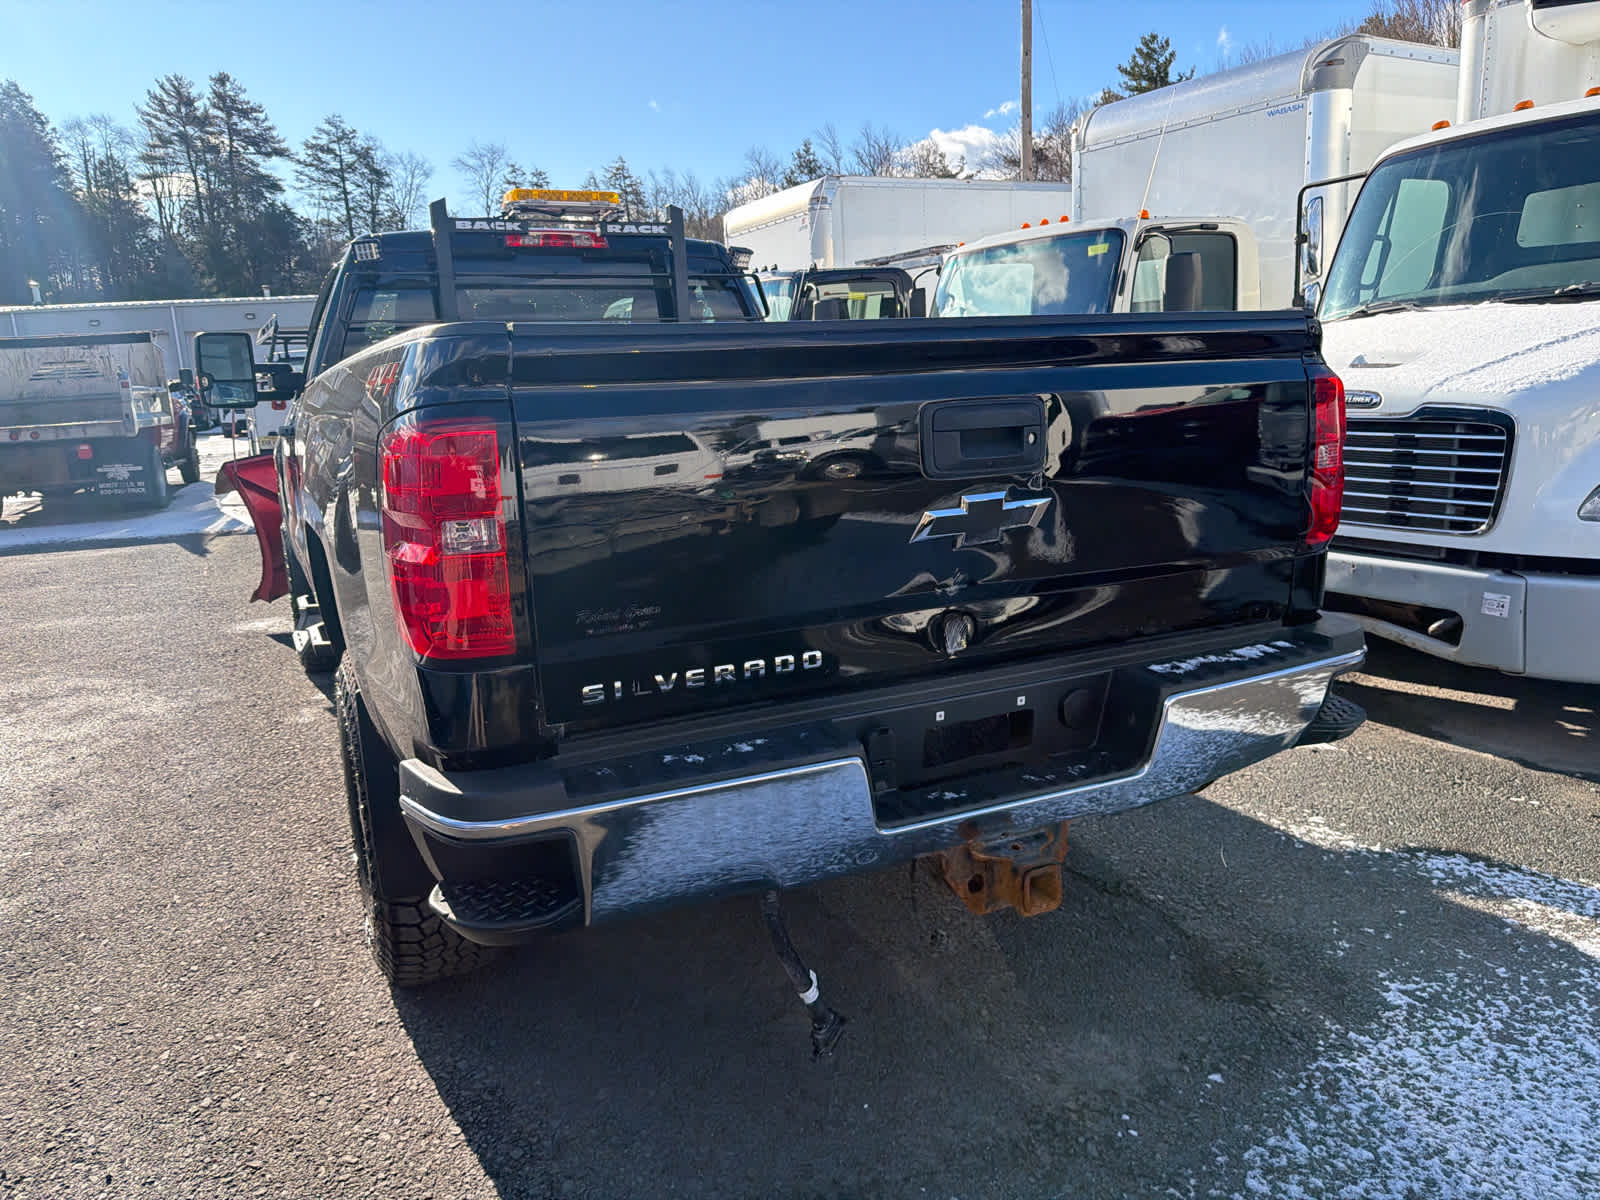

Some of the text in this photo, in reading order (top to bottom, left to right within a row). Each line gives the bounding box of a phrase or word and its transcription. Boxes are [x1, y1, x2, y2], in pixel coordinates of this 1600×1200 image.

[1267, 104, 1304, 117] WABASH
[456, 220, 667, 234] BACK RACK
[582, 650, 823, 704] SILVERADO
